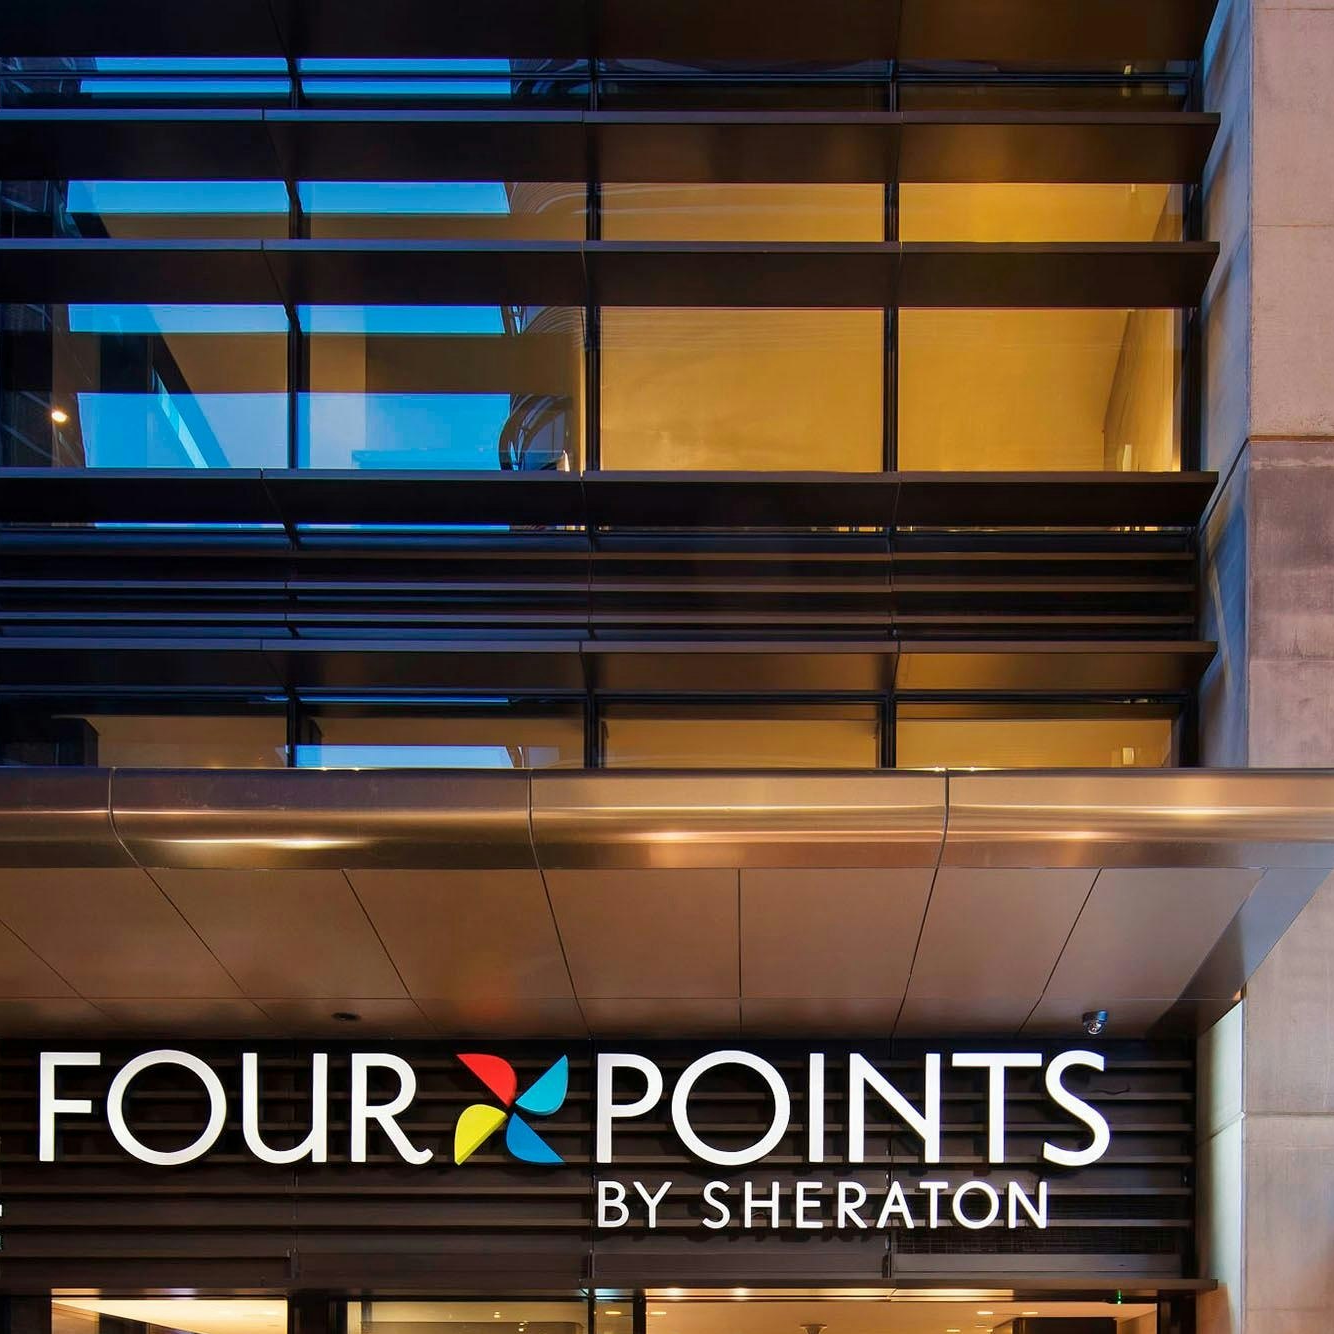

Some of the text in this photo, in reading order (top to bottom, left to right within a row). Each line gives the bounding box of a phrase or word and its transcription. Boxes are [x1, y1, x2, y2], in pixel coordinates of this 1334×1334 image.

[38, 1049, 1112, 1167] FOUR POINTS
[596, 1180, 1049, 1230] BY SHERATON
